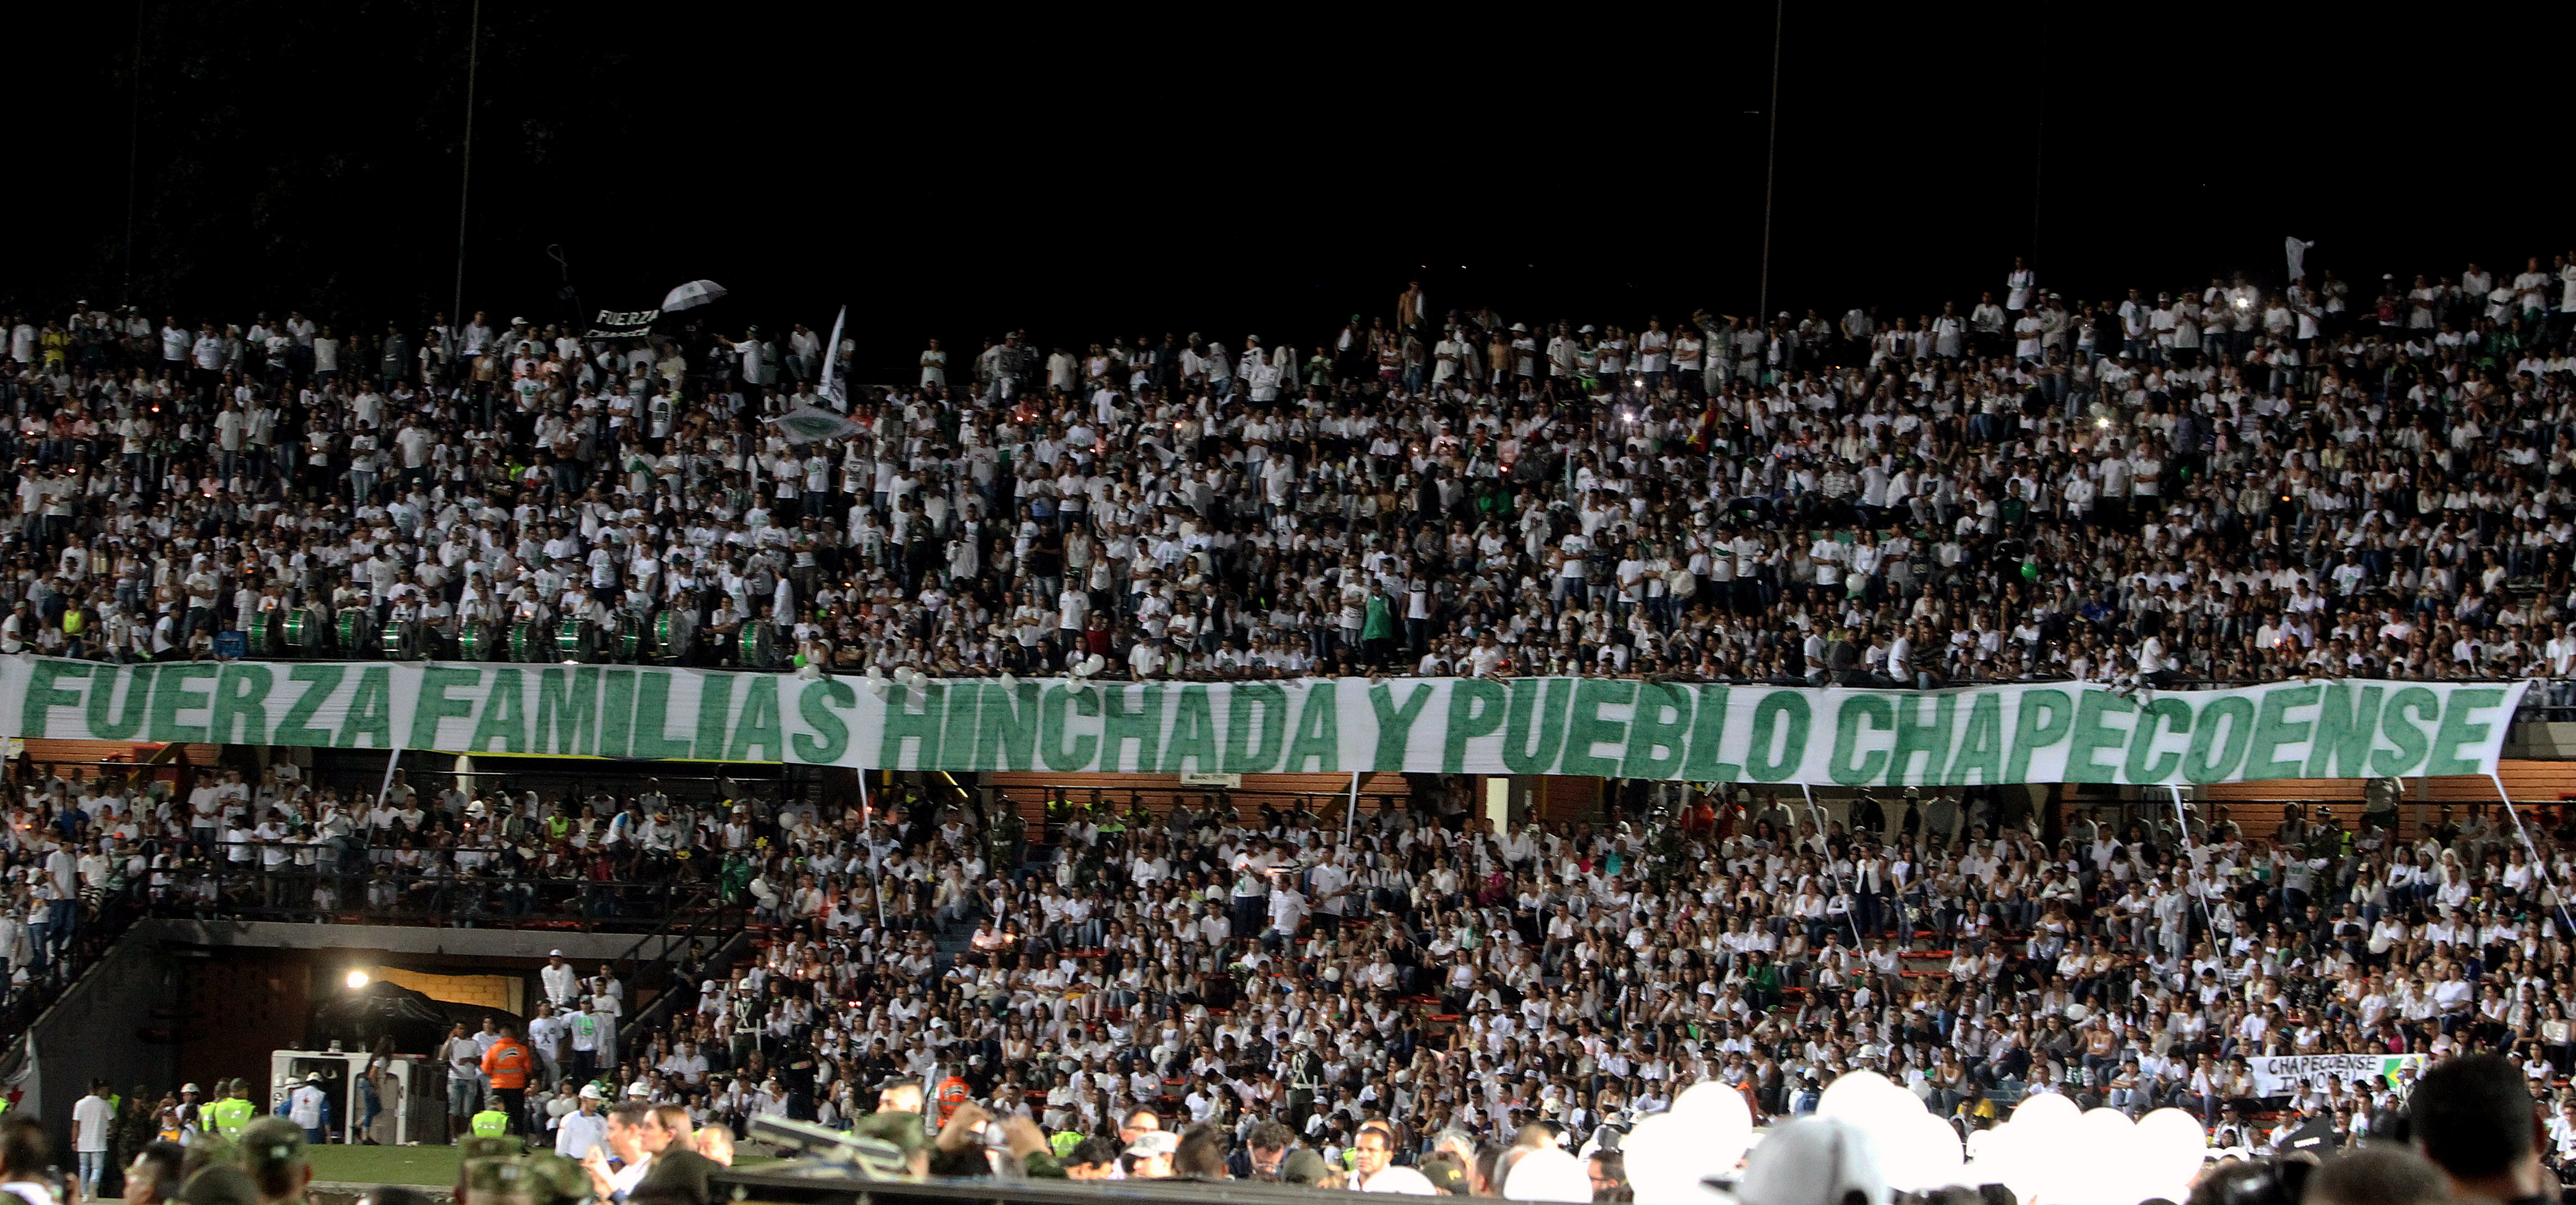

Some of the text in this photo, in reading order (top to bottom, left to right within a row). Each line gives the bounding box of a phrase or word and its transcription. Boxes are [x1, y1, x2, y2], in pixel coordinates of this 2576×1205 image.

[596, 309, 659, 326] FUERZA
[21, 659, 2508, 786] FUERZA FAMILIAS HINCHADA Y PUEBLO CHAPECOENSE
[2268, 1055, 2377, 1075] CHAPECOENSE
